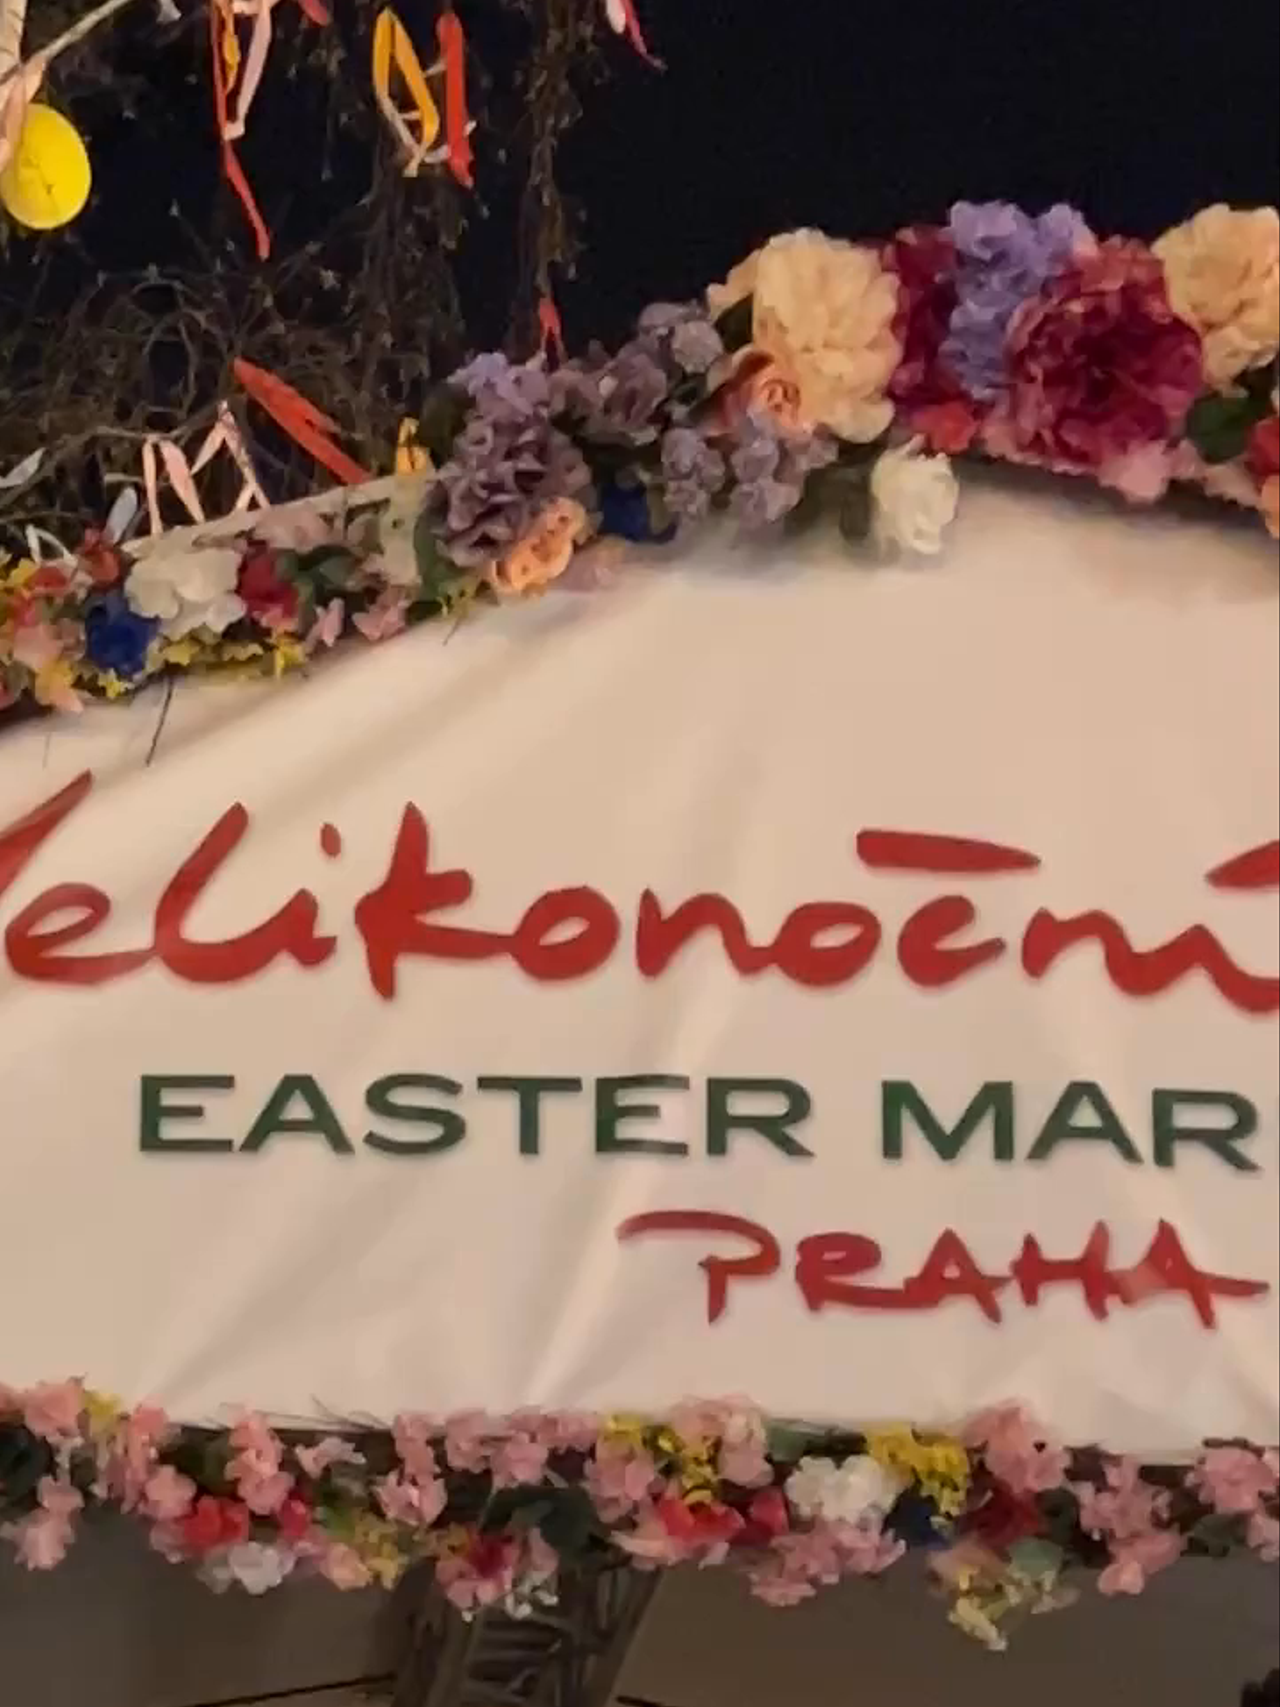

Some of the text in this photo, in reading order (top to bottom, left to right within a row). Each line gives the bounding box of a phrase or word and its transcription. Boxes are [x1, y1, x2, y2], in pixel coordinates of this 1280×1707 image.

[137, 1072, 1261, 1173] EASTER MAR
[615, 1209, 1269, 1327] PRAHA
